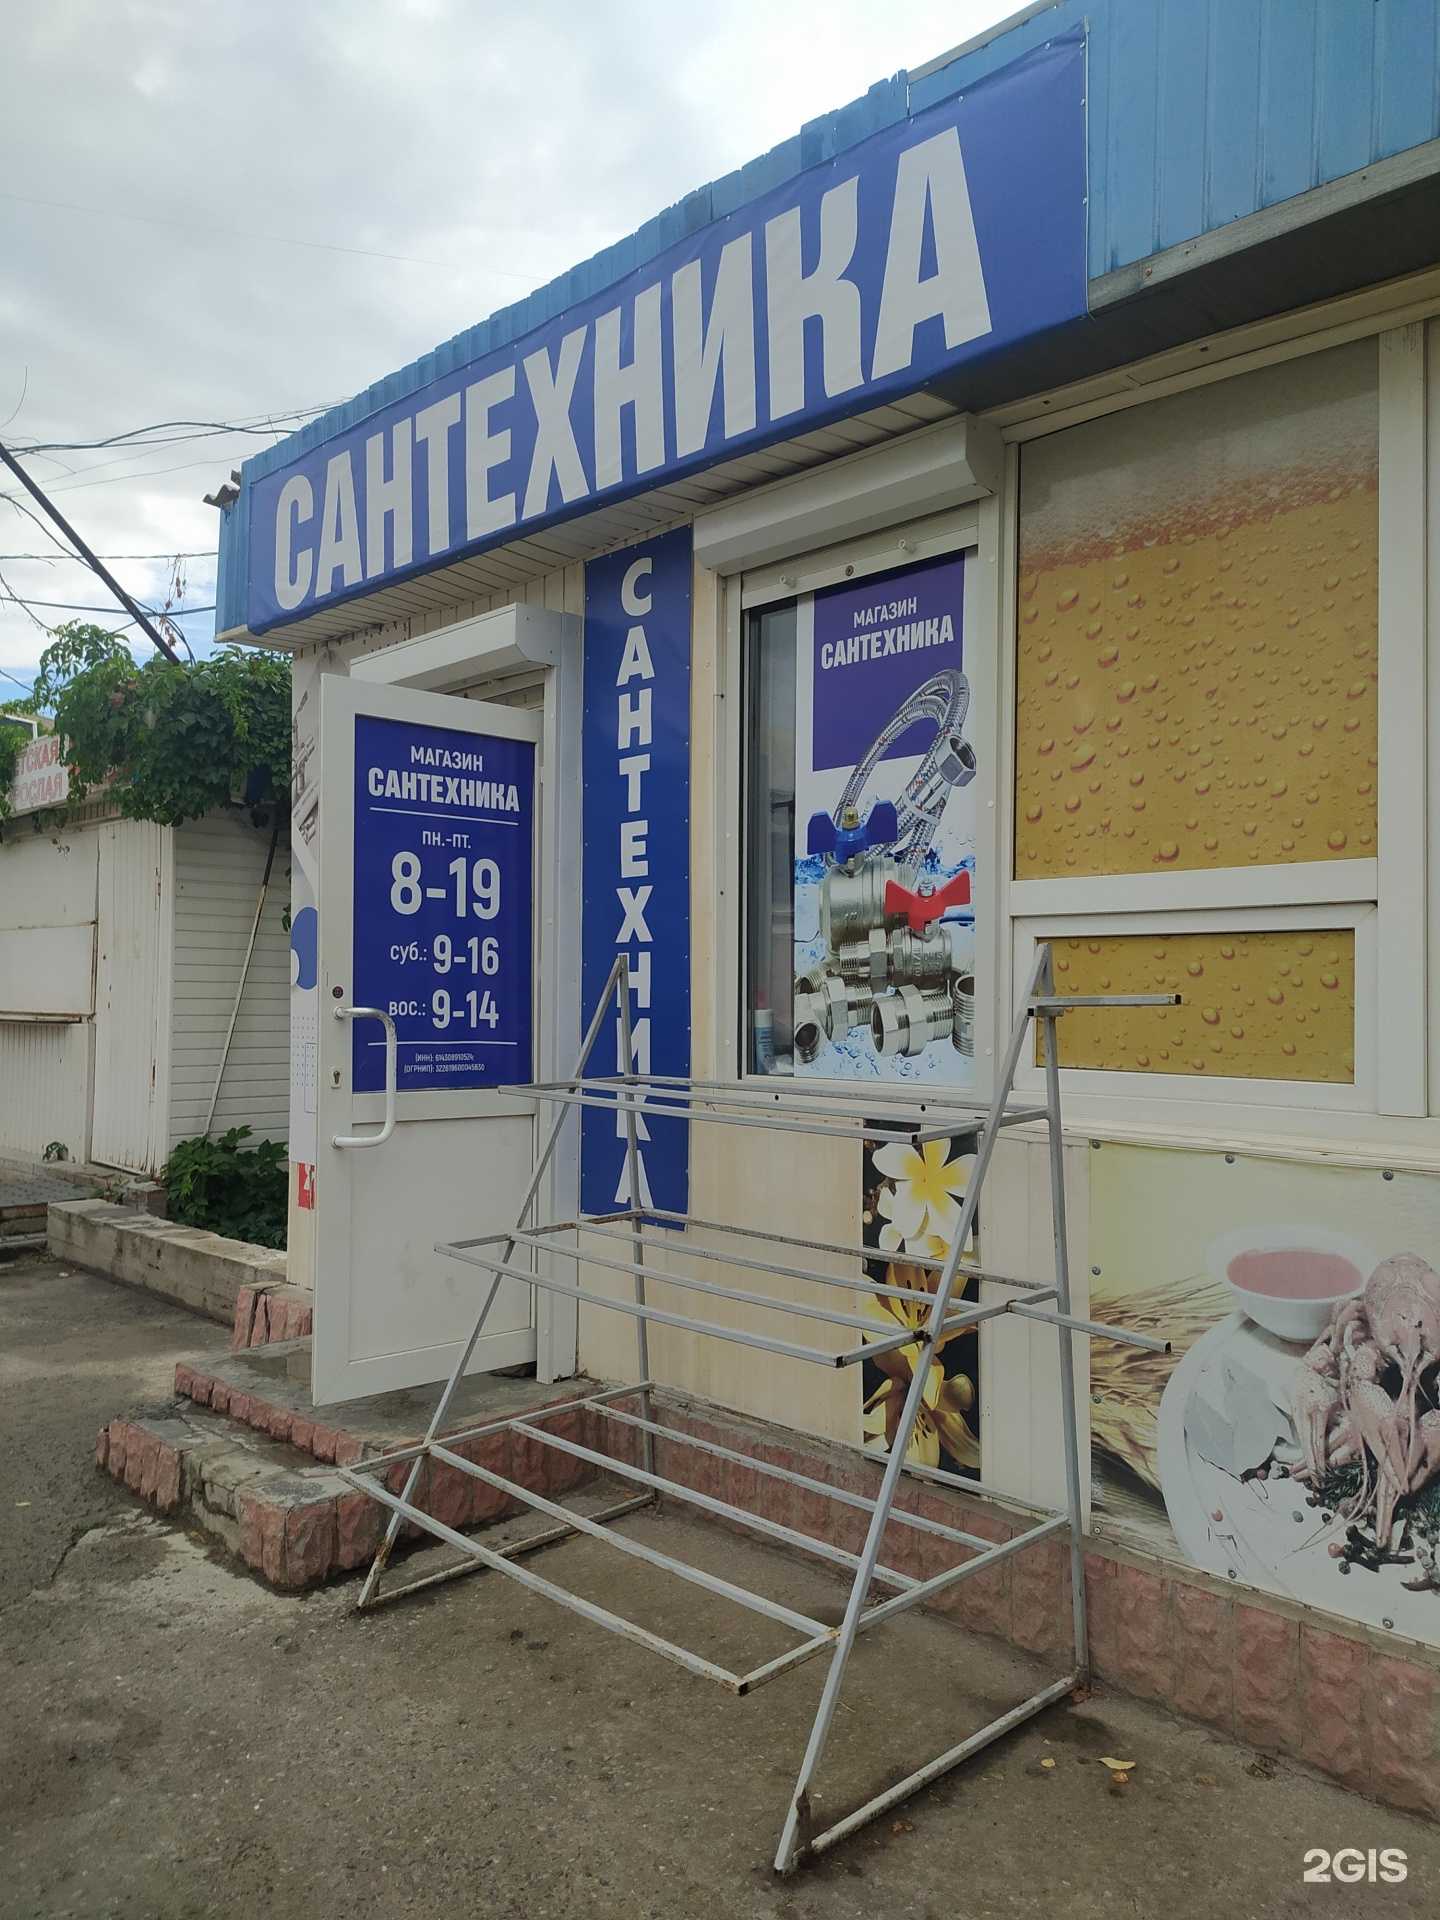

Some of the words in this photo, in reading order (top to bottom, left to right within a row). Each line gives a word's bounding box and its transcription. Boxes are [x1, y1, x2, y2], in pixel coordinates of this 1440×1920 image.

[274, 125, 993, 612] САНТЕХНИКА
[853, 596, 918, 628] МАГАЗИН
[820, 614, 954, 670] САНТЕХНИКА
[410, 745, 484, 772] МАГАЗИН
[368, 767, 520, 812] САНТЕХНИКА
[422, 830, 472, 849] ПН.-ПТ.
[390, 851, 501, 920] 8-19
[433, 934, 499, 976] 9-16
[432, 989, 499, 1029] 9-14
